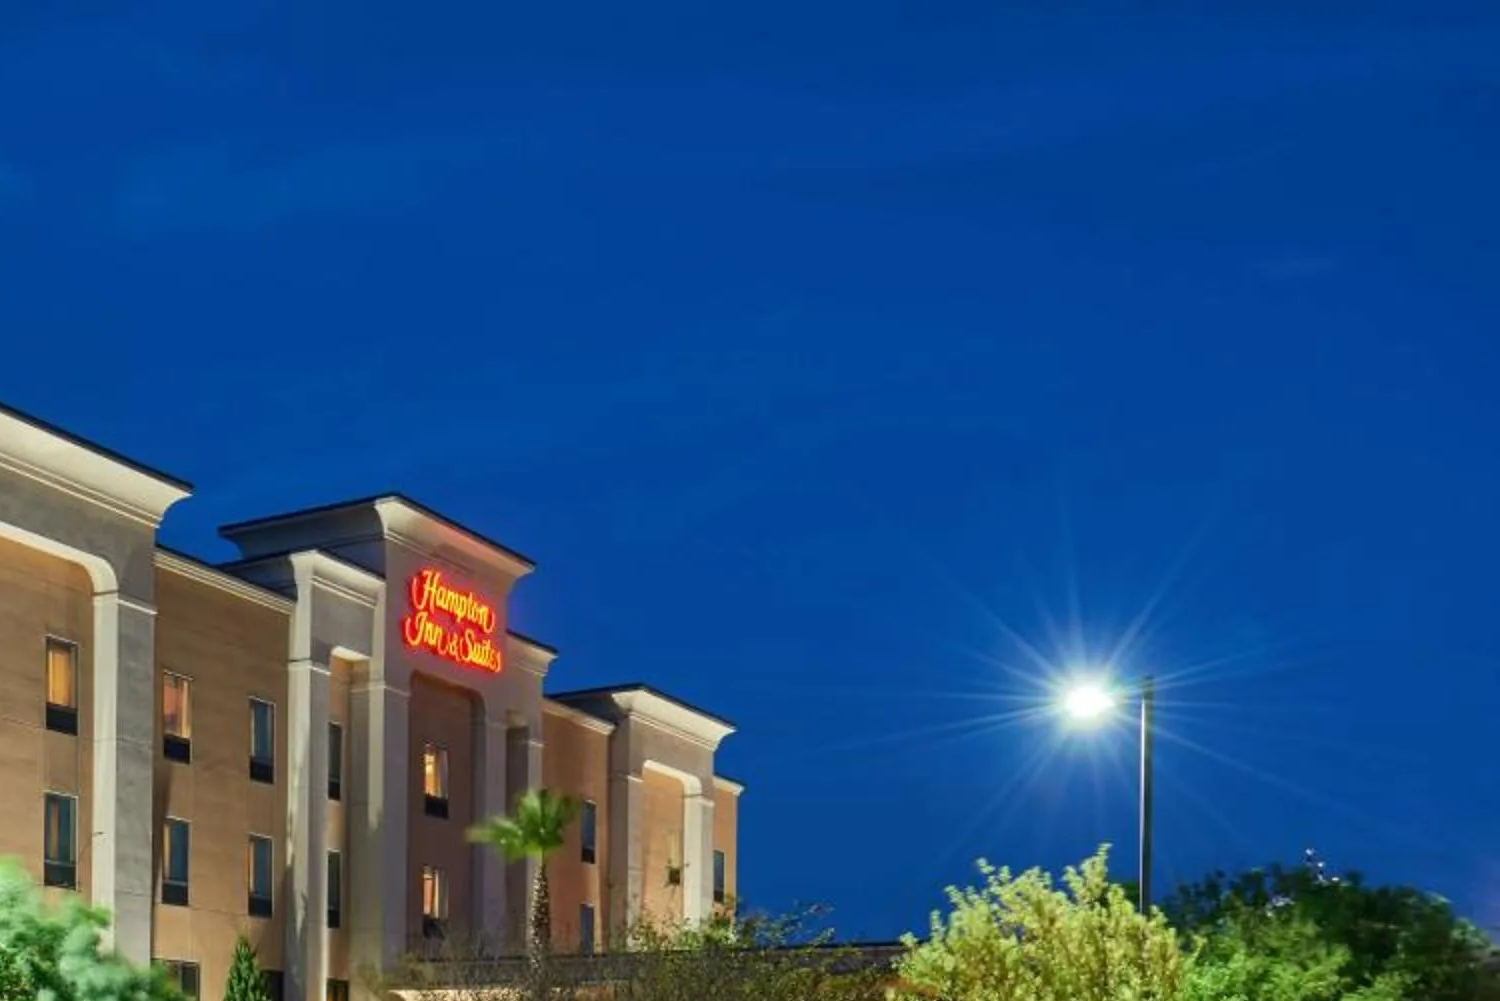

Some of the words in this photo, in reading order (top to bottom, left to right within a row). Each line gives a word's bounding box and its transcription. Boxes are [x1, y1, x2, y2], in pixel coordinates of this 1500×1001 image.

[411, 569, 496, 634] Hampton
[405, 611, 451, 656] Inn
[446, 632, 462, 662] &
[460, 628, 502, 673] Suites
